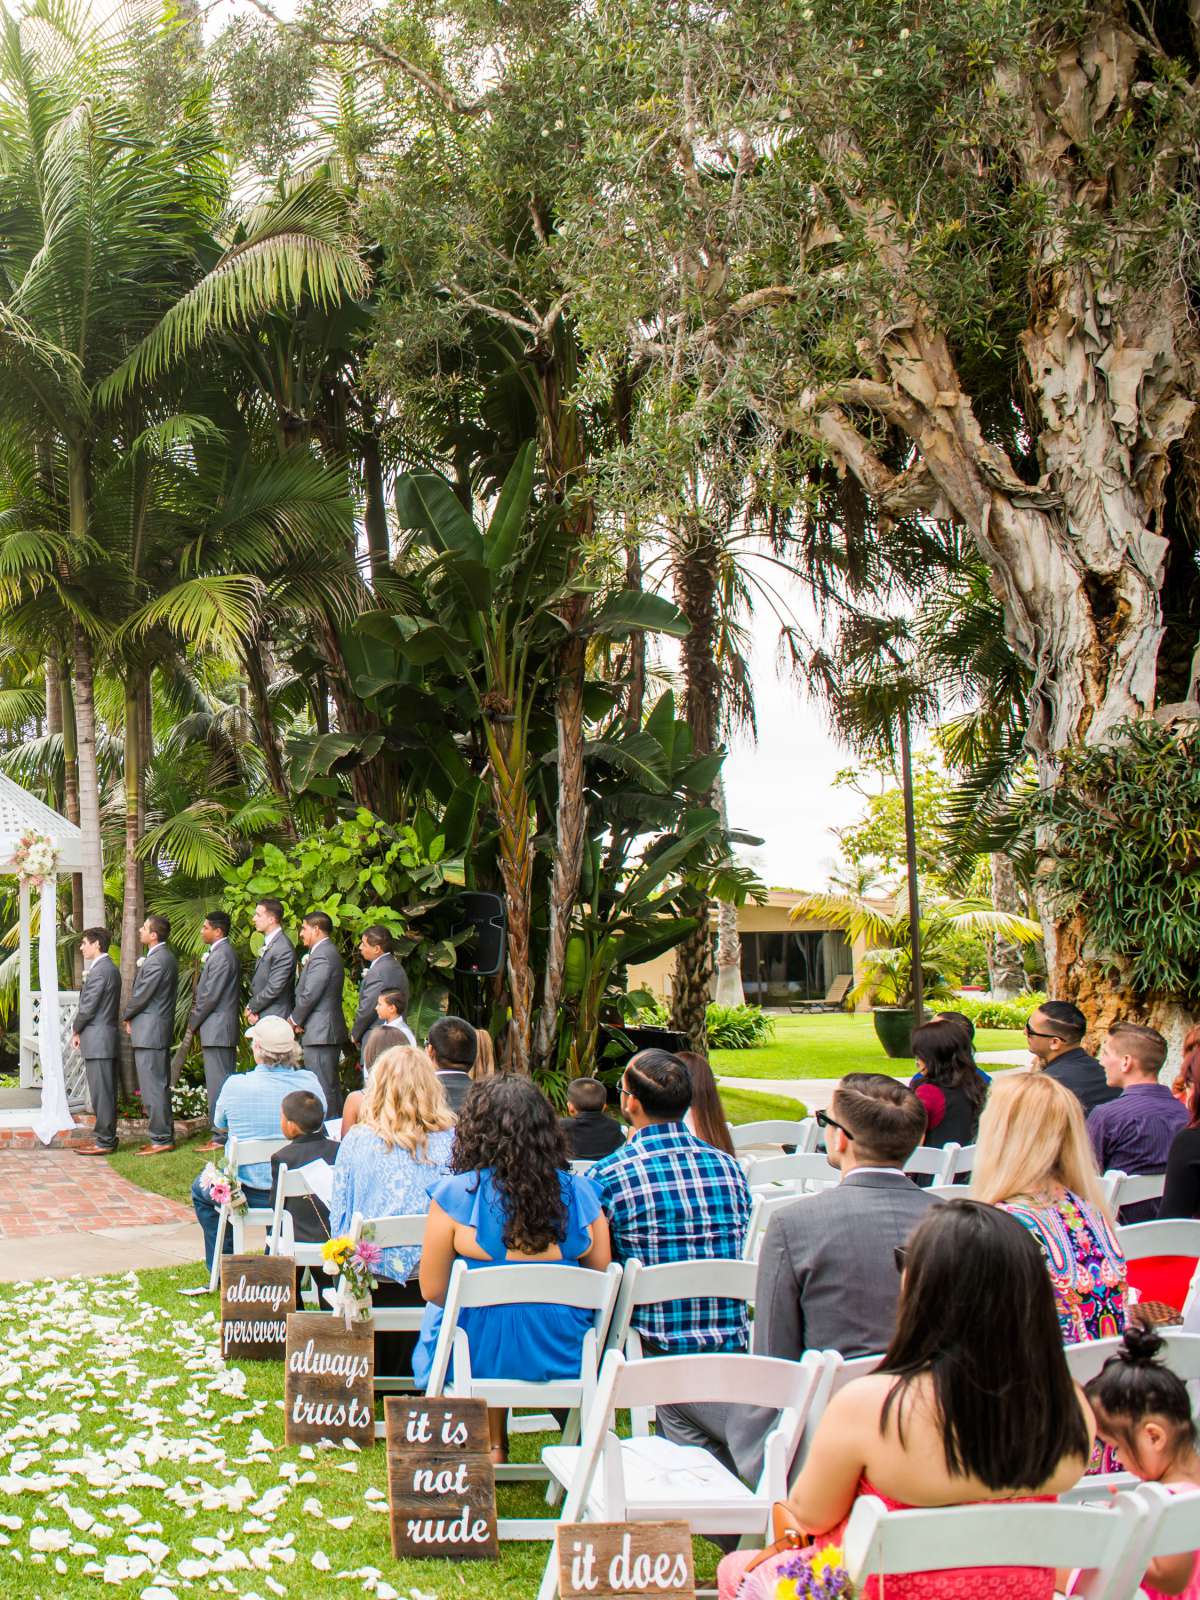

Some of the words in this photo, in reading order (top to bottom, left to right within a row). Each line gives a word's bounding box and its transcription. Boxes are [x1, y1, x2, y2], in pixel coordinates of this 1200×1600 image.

[226, 1275, 291, 1311] always
[223, 1320, 286, 1354] persevere
[289, 1338, 369, 1388] always
[292, 1394, 371, 1429] trusts
[406, 1411, 432, 1443] it
[441, 1412, 468, 1445] is
[413, 1463, 469, 1494] not
[406, 1505, 490, 1543] rude
[571, 1541, 599, 1590] it
[608, 1532, 688, 1589] does
